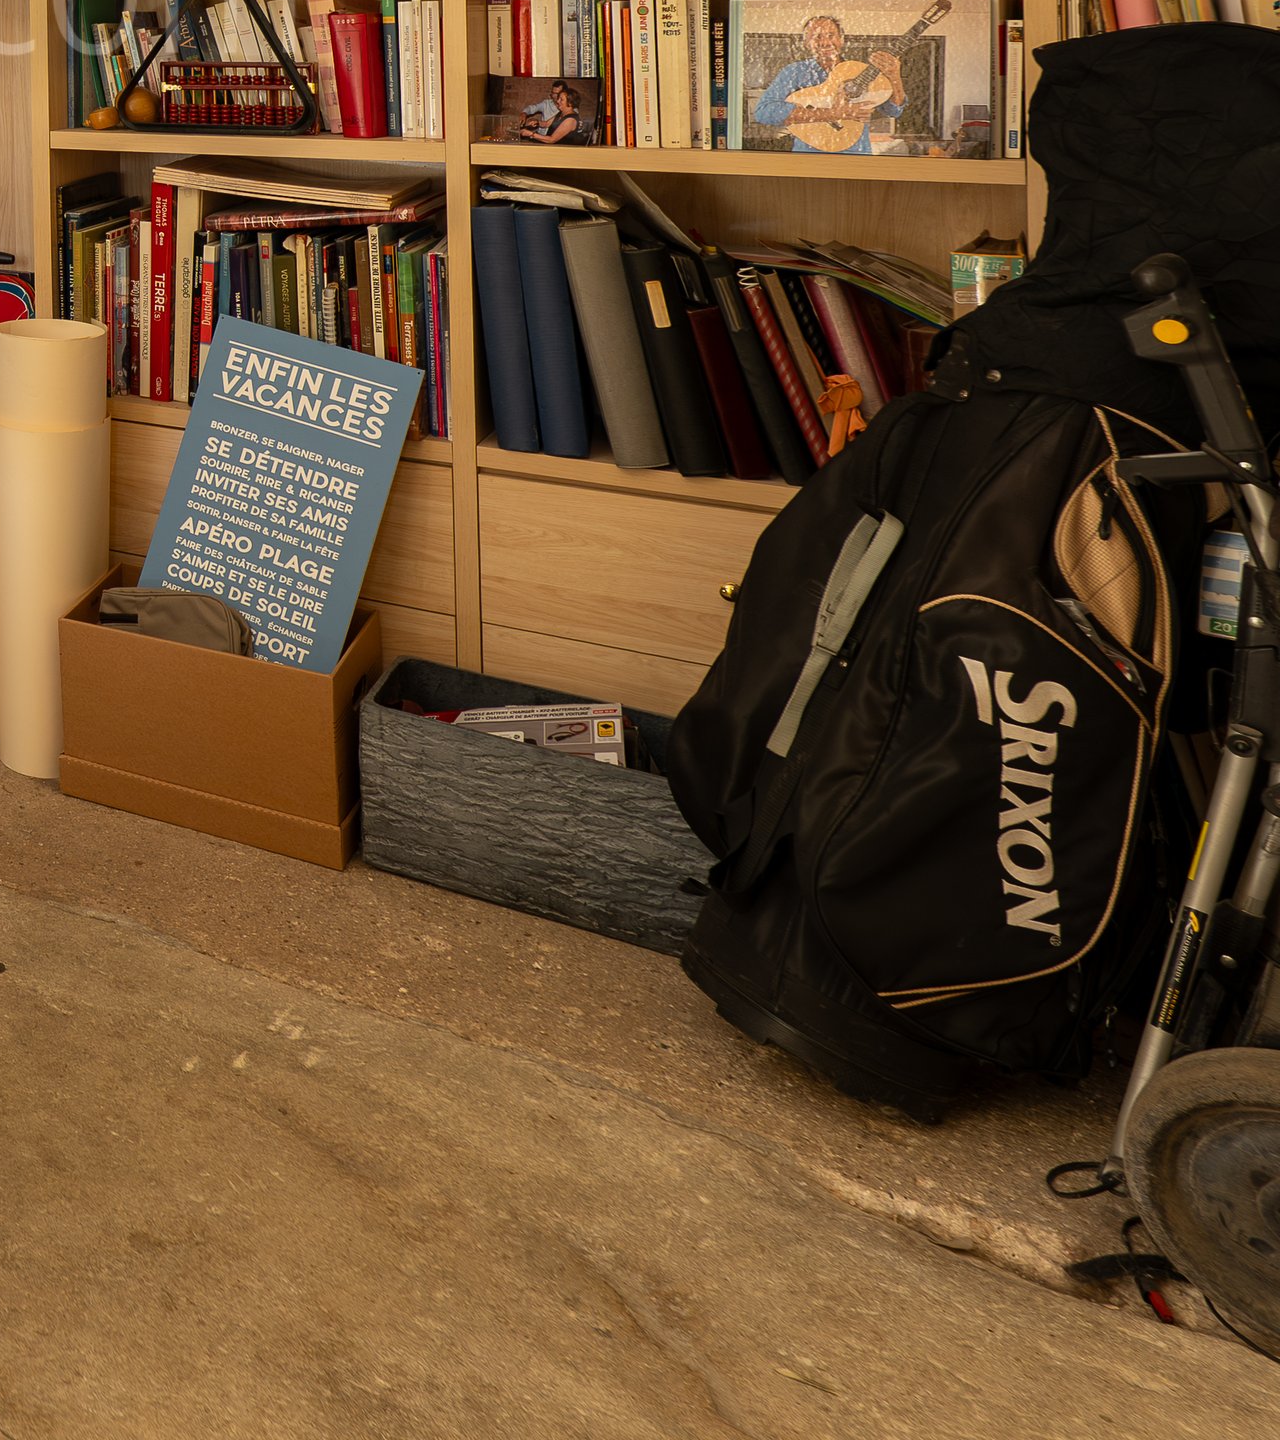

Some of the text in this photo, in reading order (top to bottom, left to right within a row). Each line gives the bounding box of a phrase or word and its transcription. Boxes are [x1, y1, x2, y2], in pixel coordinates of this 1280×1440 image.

[640, 33, 649, 44] DES
[640, 45, 650, 64] PARIS
[712, 22, 724, 39] FÊTE
[713, 40, 724, 56] UNE
[641, 64, 650, 72] LE
[181, 258, 191, 299] géographie
[201, 280, 213, 325] Deutschland
[370, 234, 383, 333] PETITE HISTOIRE DE TOULOUSE
[403, 320, 414, 358] Terrasses
[221, 371, 385, 440] VACANCES
[225, 347, 393, 415] ENFIN LES
[205, 436, 360, 501] SE DÉTENDRE
[210, 420, 365, 477] BRONZER, SE BAIGNER, NAGER
[190, 484, 345, 547] PROFITER DE SA FAMILLE
[195, 468, 350, 532] INVITER SES AMIS
[200, 455, 354, 515] SOURIRE, RIRE & RICANER
[179, 516, 335, 586] APÉRO PLAGE
[186, 499, 340, 561] SORTIR, DANSER & FAIRE LA FÊTE
[167, 563, 226, 595] COUPS
[227, 586, 254, 607] DE
[255, 597, 318, 633] SOLEIL
[171, 548, 324, 615] S'AIMER ET SE LE DIRE
[175, 535, 329, 600] FAIRE DES CHÂTEAUX DE SABLE
[267, 621, 314, 647] ÉCHANGER
[993, 669, 1079, 940] SRIXON
